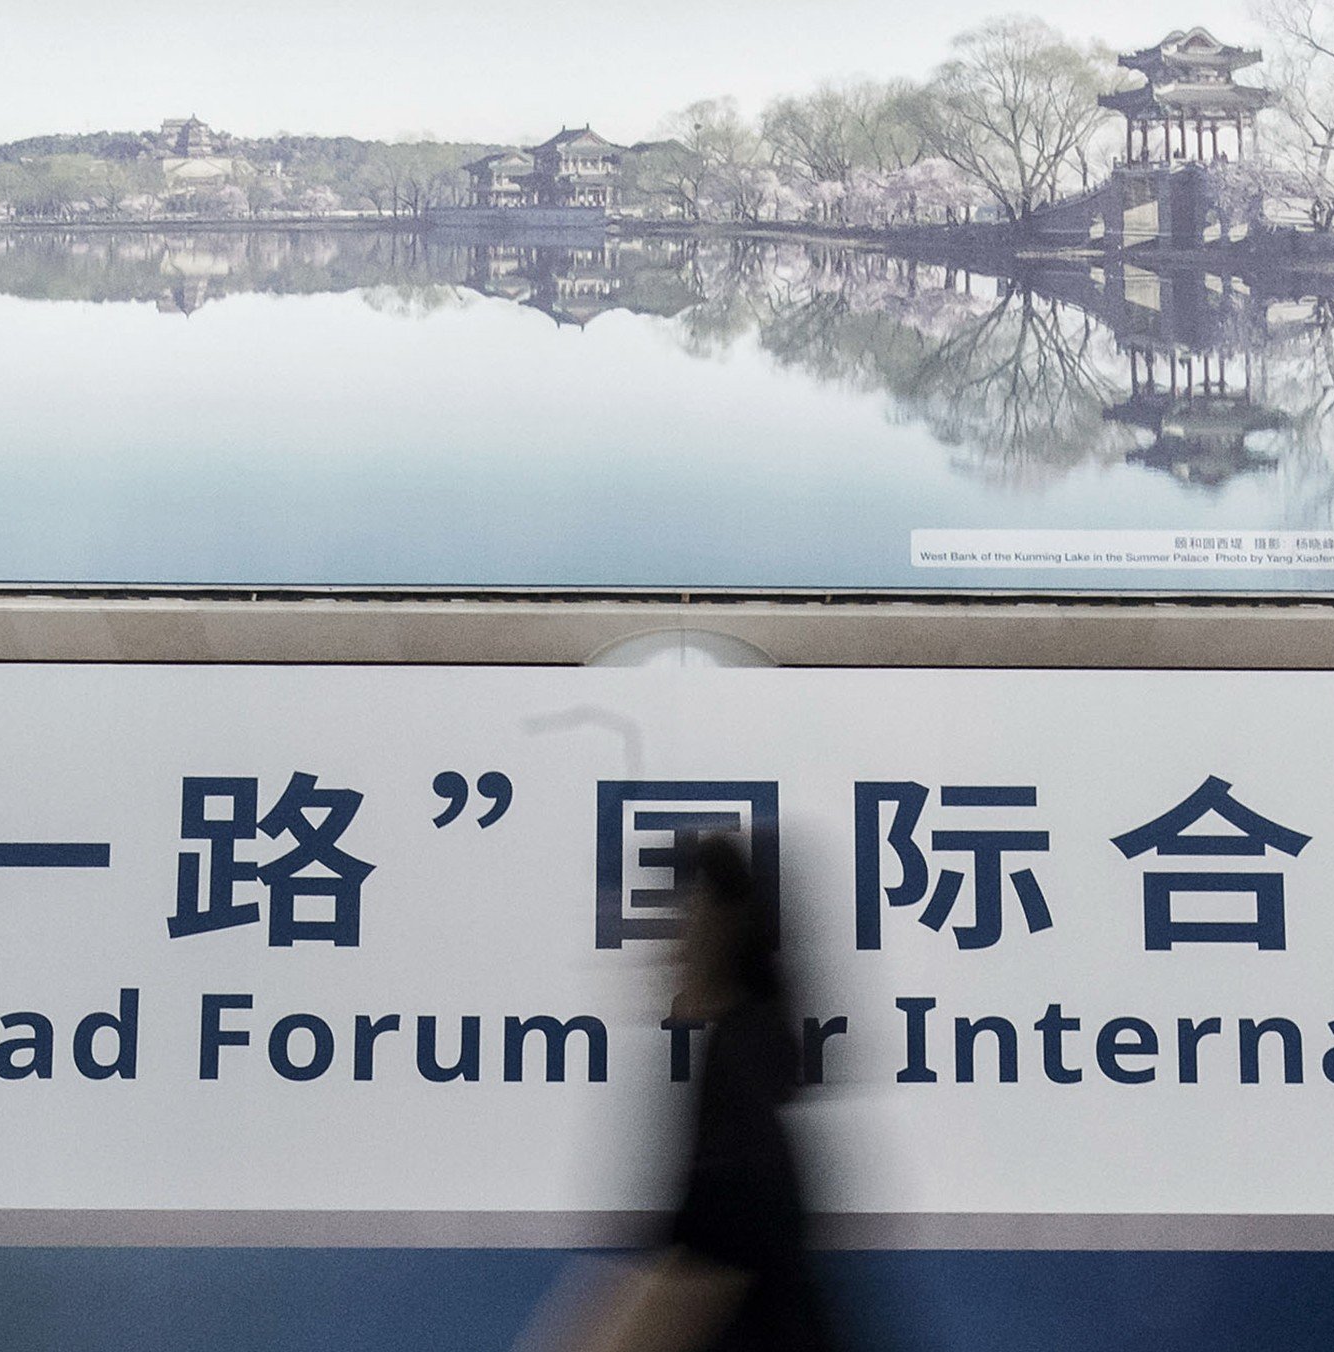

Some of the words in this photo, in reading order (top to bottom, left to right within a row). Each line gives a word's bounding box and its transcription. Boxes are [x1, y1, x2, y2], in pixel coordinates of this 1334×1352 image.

[920, 552, 947, 562] West
[951, 552, 978, 562] Bank
[981, 552, 991, 562] of
[994, 552, 1012, 562] the
[1014, 552, 1062, 564] Kunming
[1065, 552, 1090, 562] Lake
[1093, 552, 1103, 562] in
[1106, 552, 1123, 562] the
[1125, 552, 1169, 563] Summer
[1173, 553, 1209, 563] Palace
[1216, 553, 1247, 563] Photo
[1250, 553, 1264, 565] by
[1266, 553, 1293, 565] Yang
[200, 993, 608, 1083] Forum
[660, 992, 848, 1083] fr
